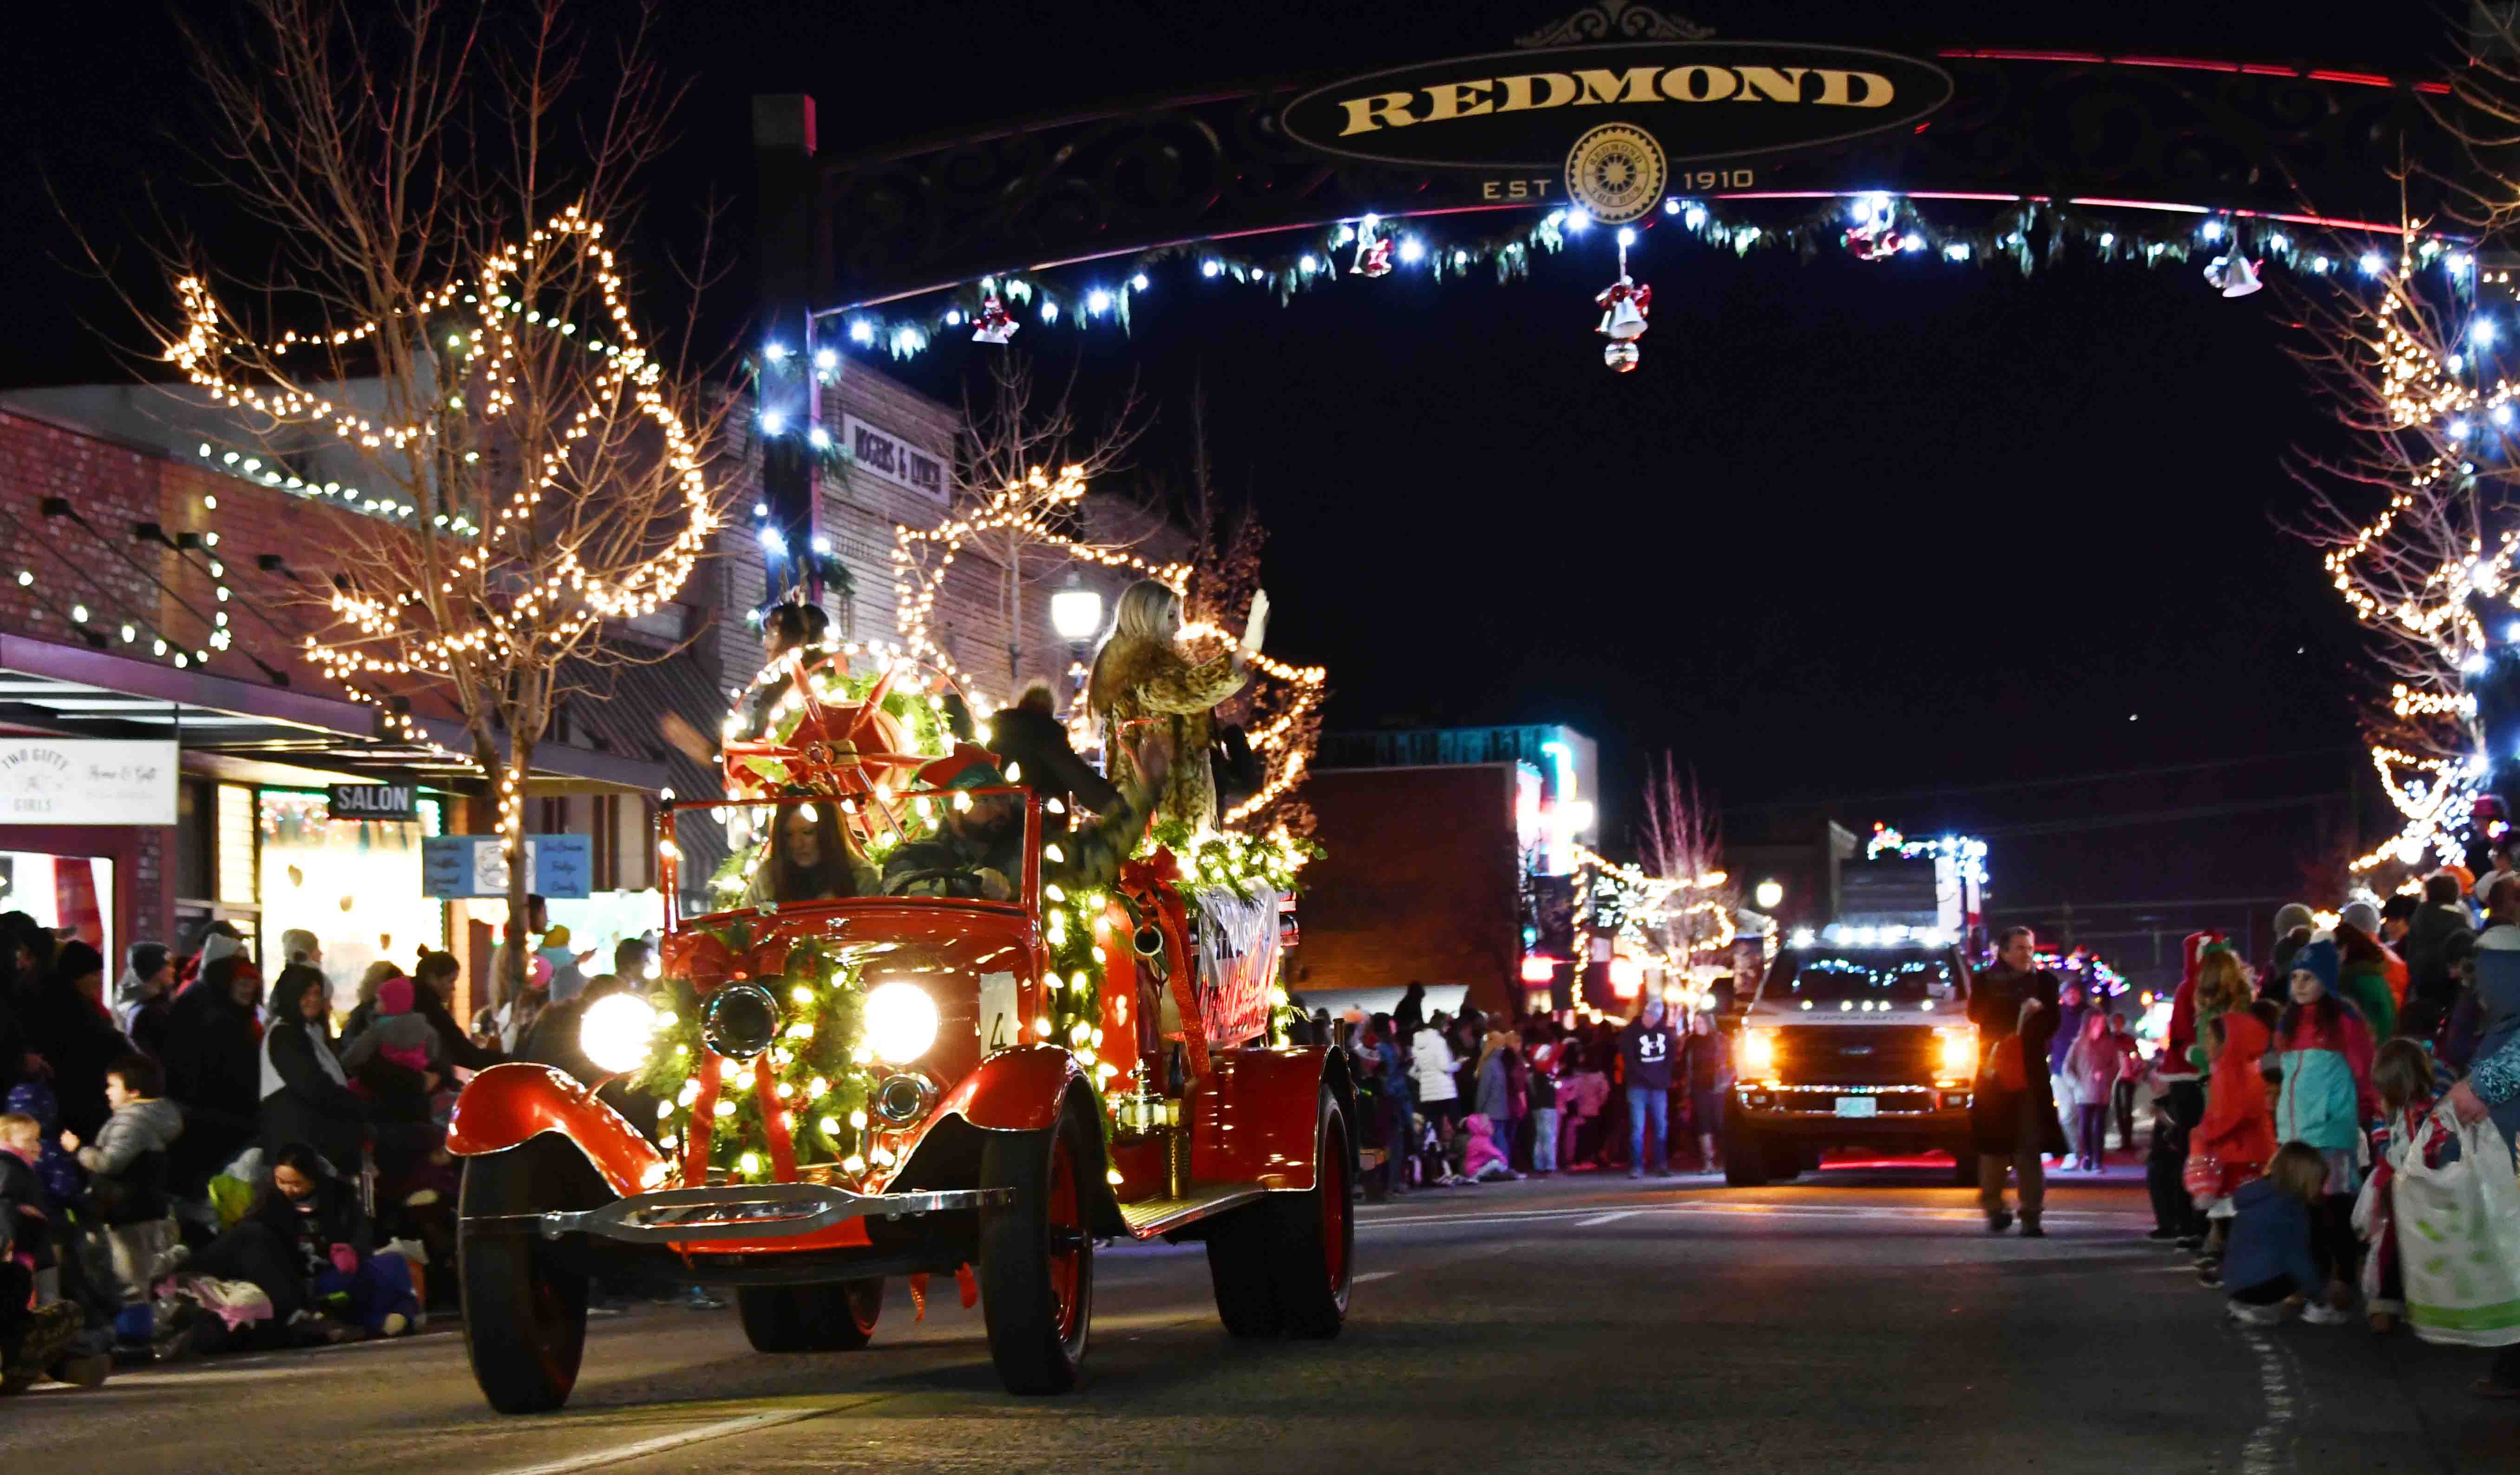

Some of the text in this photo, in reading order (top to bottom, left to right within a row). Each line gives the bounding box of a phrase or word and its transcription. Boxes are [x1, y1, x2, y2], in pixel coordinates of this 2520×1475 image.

[1338, 65, 1894, 136] REDMOND
[1483, 169, 1753, 199] EST 1910
[1, 749, 28, 769] TWO
[15, 798, 52, 812] GIRLS
[338, 786, 408, 810] SALON
[990, 1012, 1007, 1050] 4
